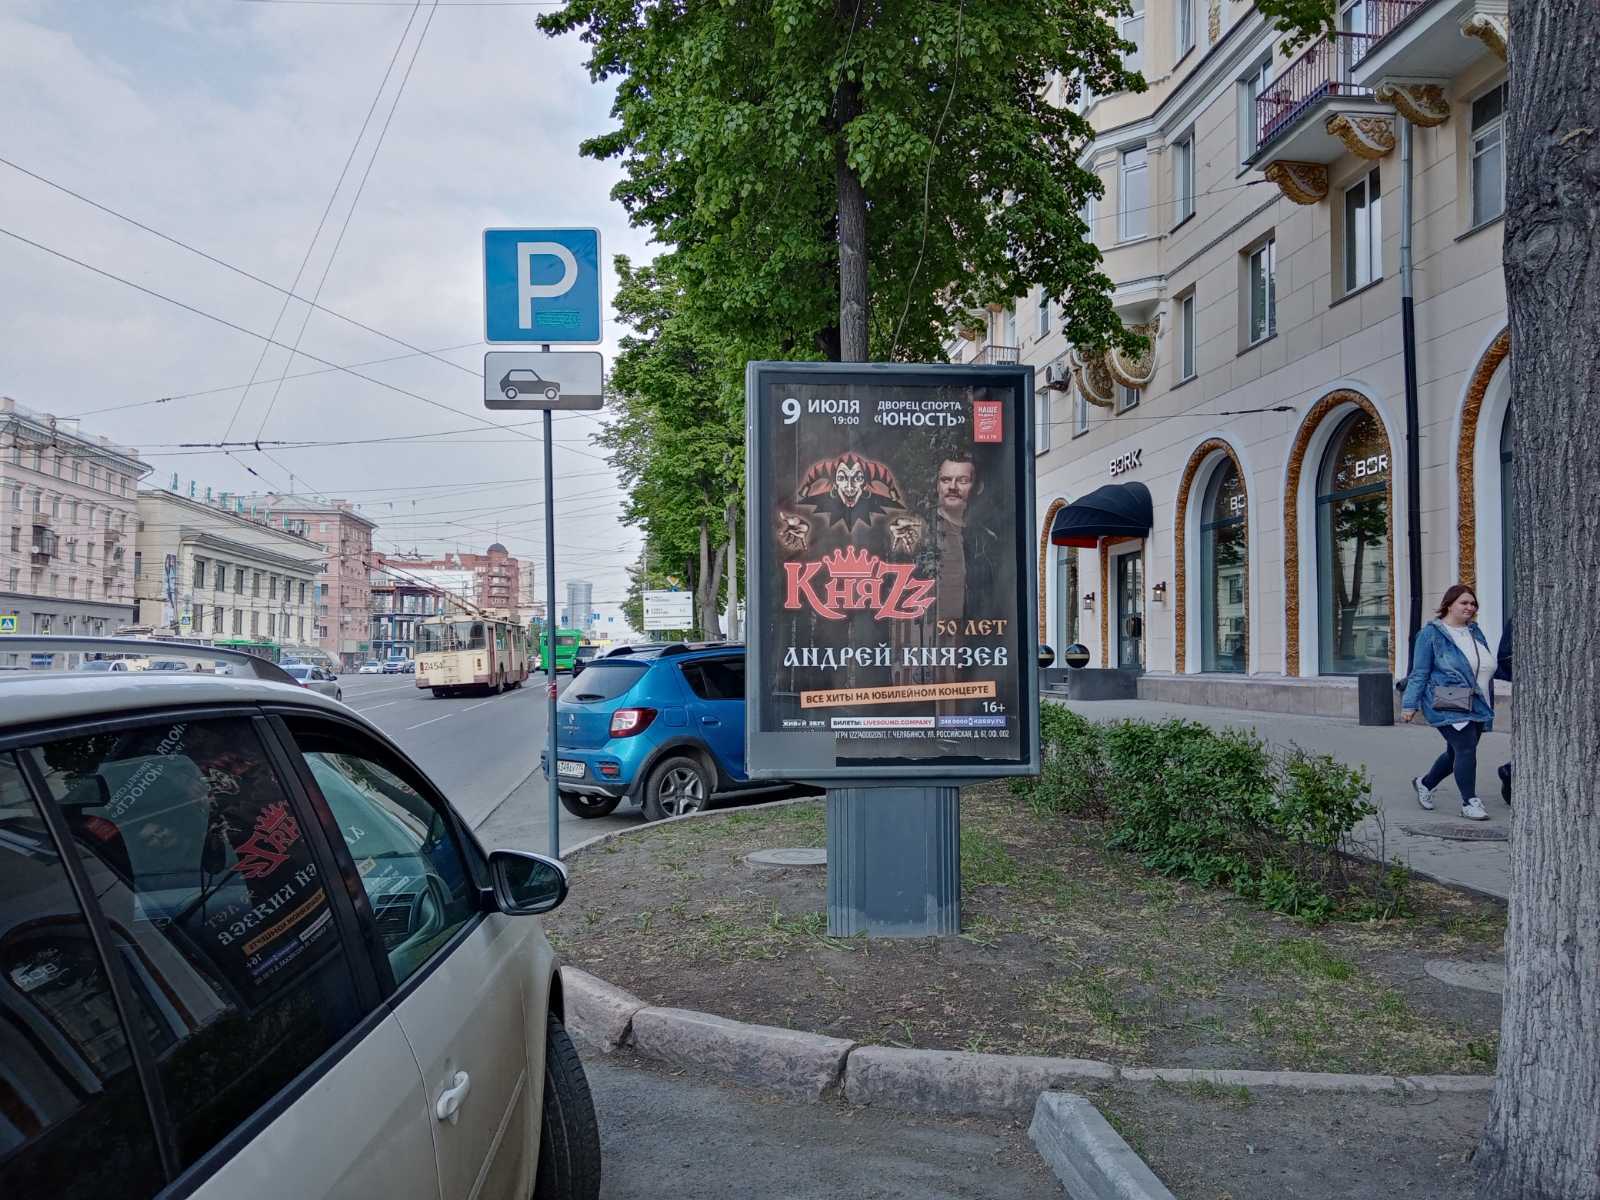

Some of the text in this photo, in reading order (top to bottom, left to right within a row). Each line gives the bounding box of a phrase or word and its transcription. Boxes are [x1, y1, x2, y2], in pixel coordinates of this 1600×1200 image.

[517, 241, 578, 329] P
[781, 398, 860, 425] 9 ИЮЛЯ
[877, 401, 961, 412] ДВОРЕЦ СПОРТА
[832, 416, 860, 425] 19:00
[874, 412, 965, 427] «ЮНОСТЬ»
[1109, 449, 1142, 476] BORK
[936, 620, 1008, 636] 50 ЛЕТ
[783, 643, 1008, 671] АНДРЕЙ КНЯЗЕВ
[806, 685, 989, 704] ВСЕ ХИТЫ НА ЮБИЛЕЙНОМ КОНЦЕРТЕ
[982, 701, 1006, 713] 16+
